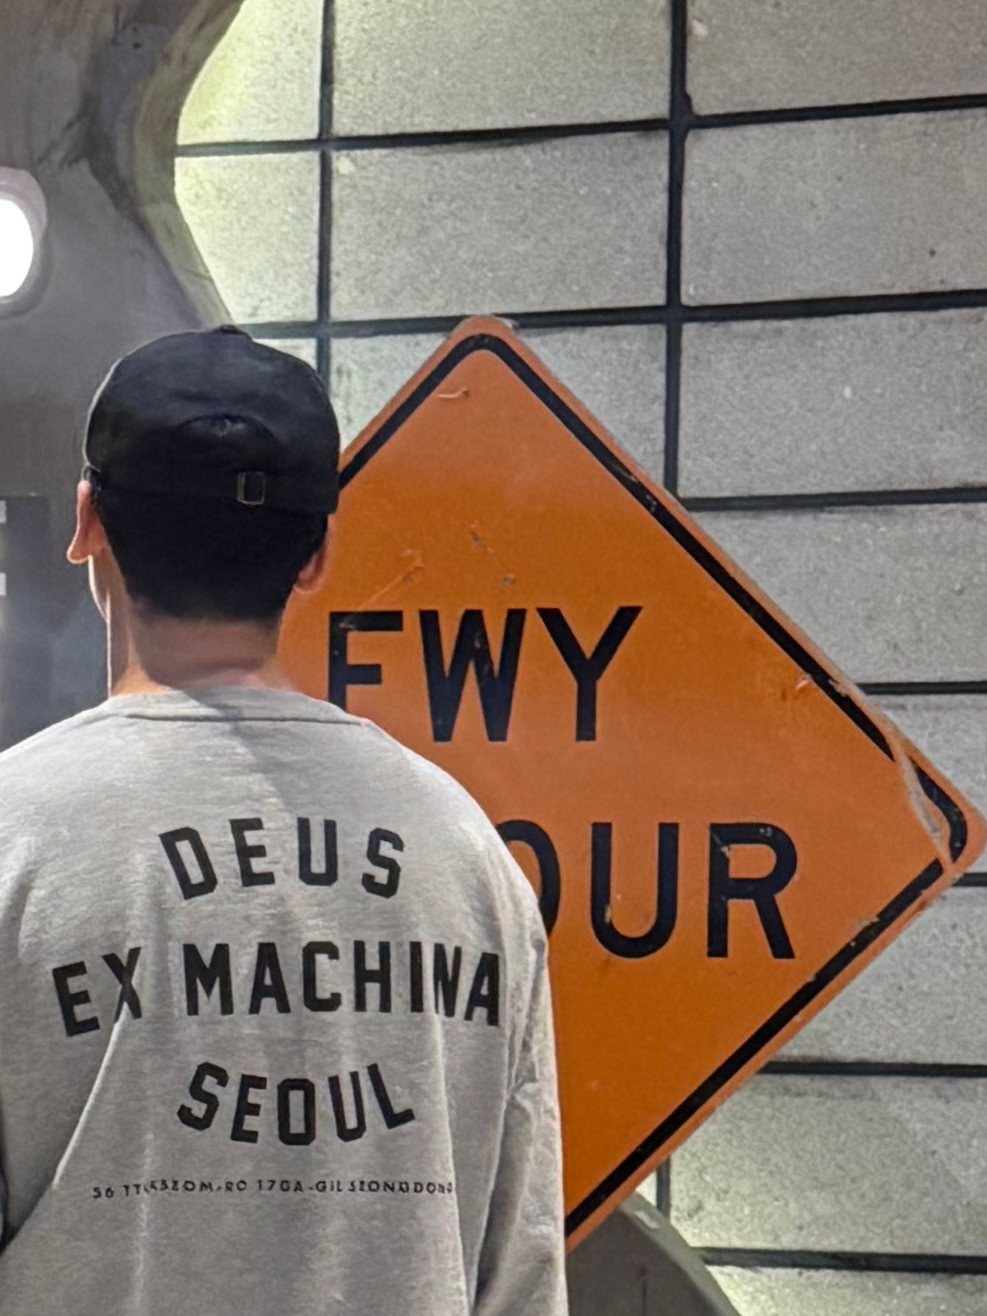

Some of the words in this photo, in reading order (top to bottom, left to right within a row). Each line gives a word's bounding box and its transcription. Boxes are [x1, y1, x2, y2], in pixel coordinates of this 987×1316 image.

[327, 605, 643, 742] FWY
[158, 817, 404, 900] DEUS
[52, 947, 143, 1037] EX
[183, 940, 500, 1026] MACHINA
[177, 1062, 415, 1146] SEOUL
